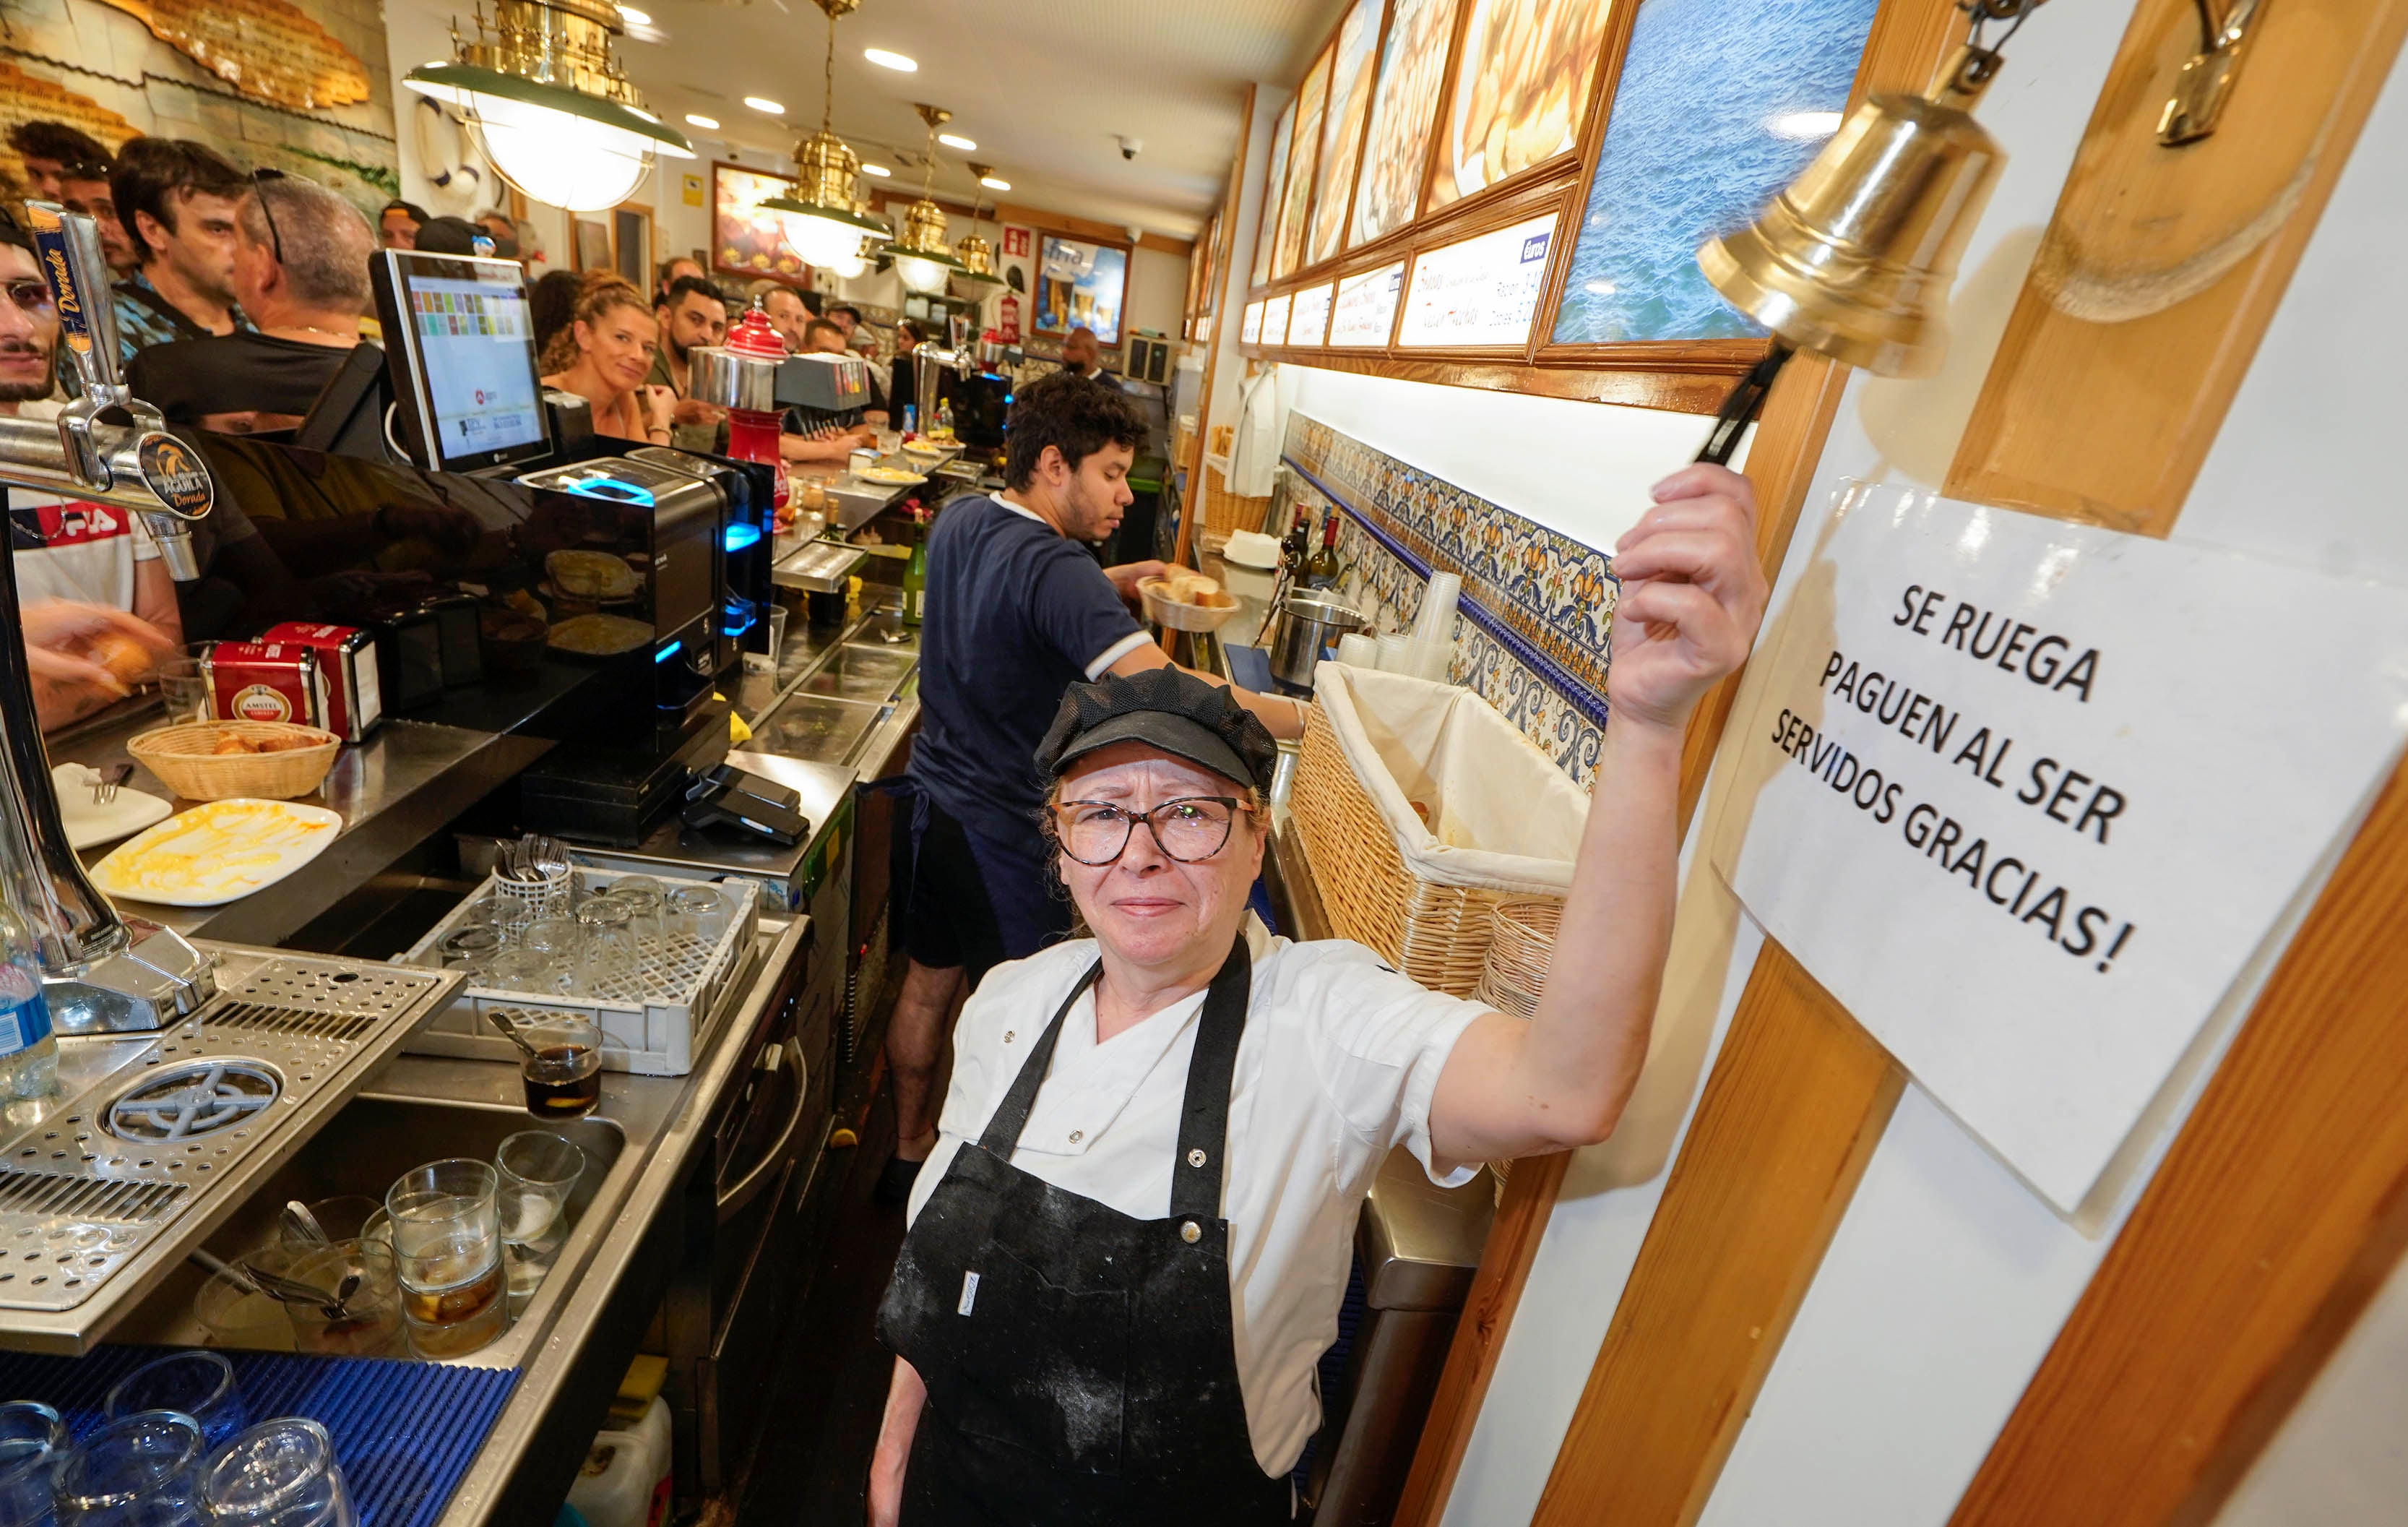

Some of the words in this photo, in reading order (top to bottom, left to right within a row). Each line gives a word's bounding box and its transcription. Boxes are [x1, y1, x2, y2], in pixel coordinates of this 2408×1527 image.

[46, 248, 80, 314] Dorada
[171, 492, 205, 507] Dorada
[1893, 584, 1946, 637] SE
[1941, 601, 2100, 703] RUEGA
[1818, 650, 1959, 754] PAGUEN
[1952, 726, 2012, 788] AL
[2016, 757, 2126, 845] SER
[1771, 707, 1904, 825] SERVIDOS
[1904, 802, 2136, 975] GRACIAS!
